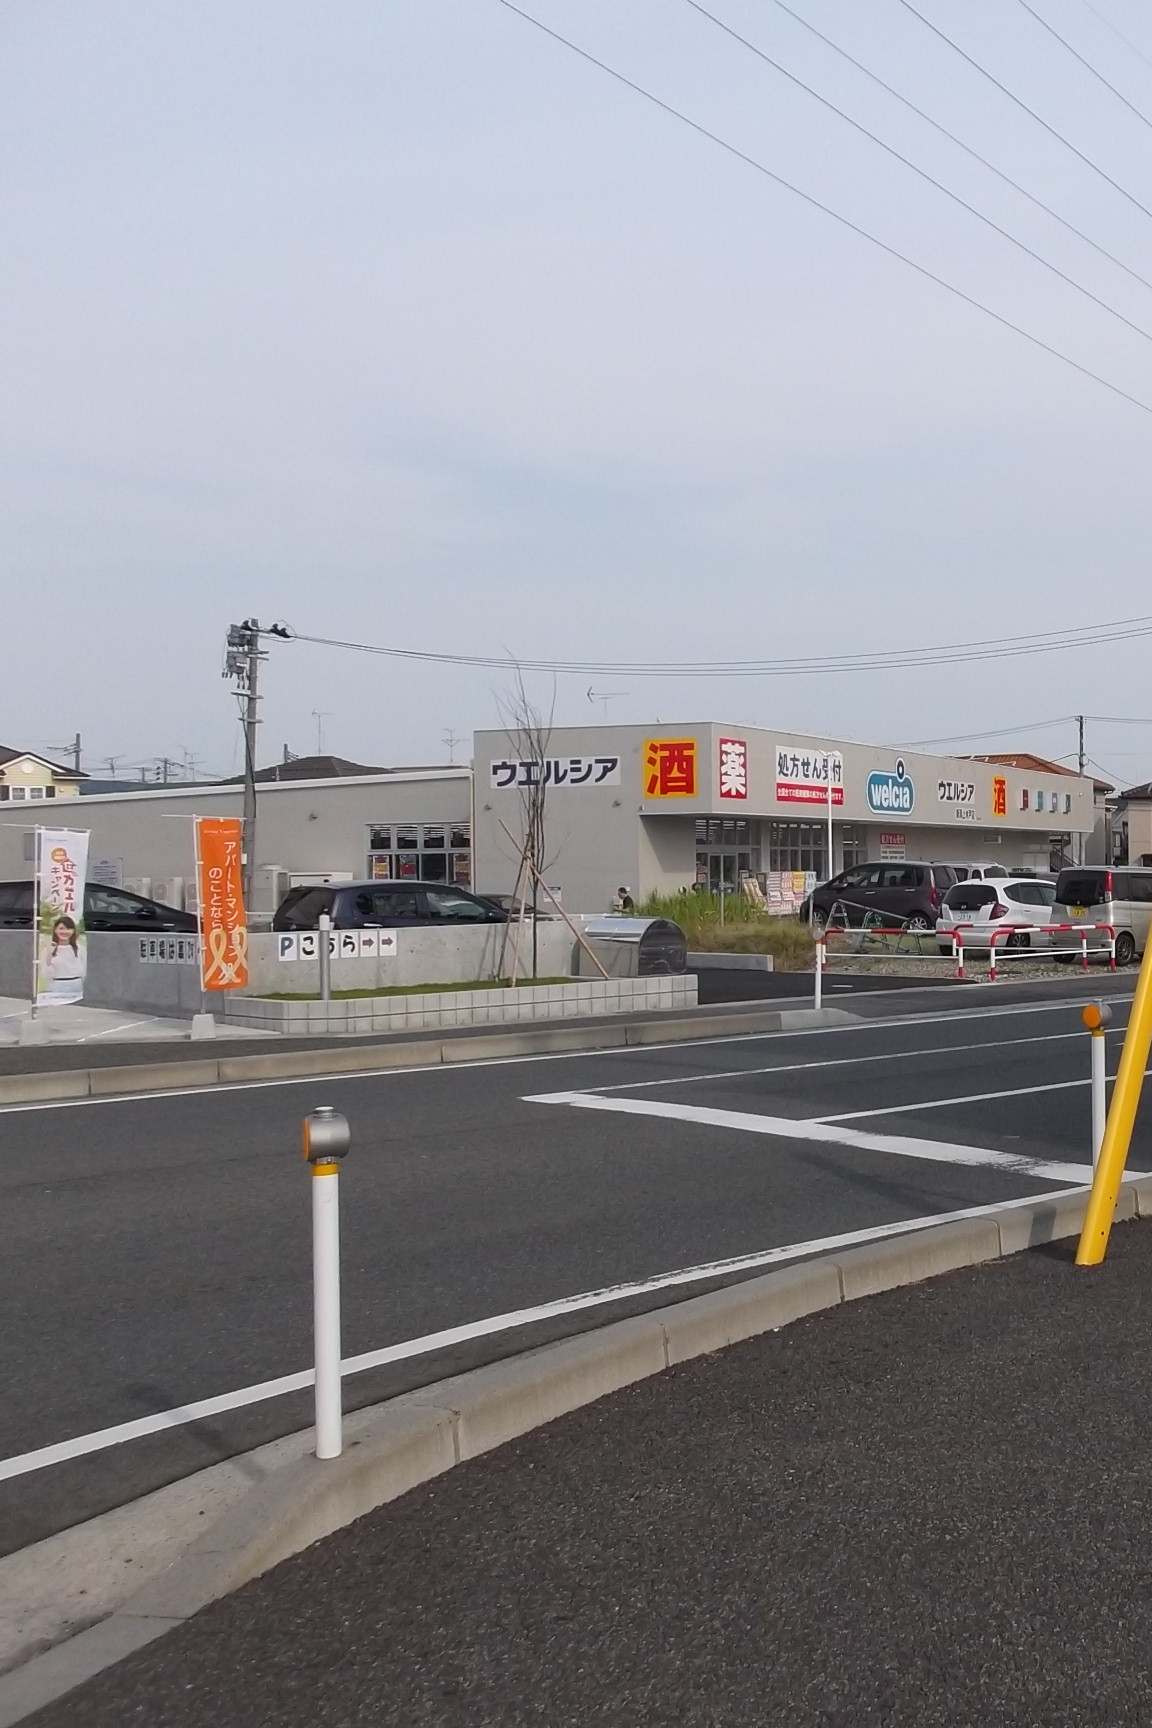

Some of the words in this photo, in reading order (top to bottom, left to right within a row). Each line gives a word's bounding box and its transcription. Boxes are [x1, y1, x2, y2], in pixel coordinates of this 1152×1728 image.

[492, 757, 618, 787] ウエルシア
[646, 742, 694, 795] 酒
[720, 742, 747, 796] 薬
[870, 772, 911, 808] welcia
[938, 780, 974, 801] ウエルシア
[994, 777, 1006, 814] 酒
[209, 867, 223, 931] のことなら
